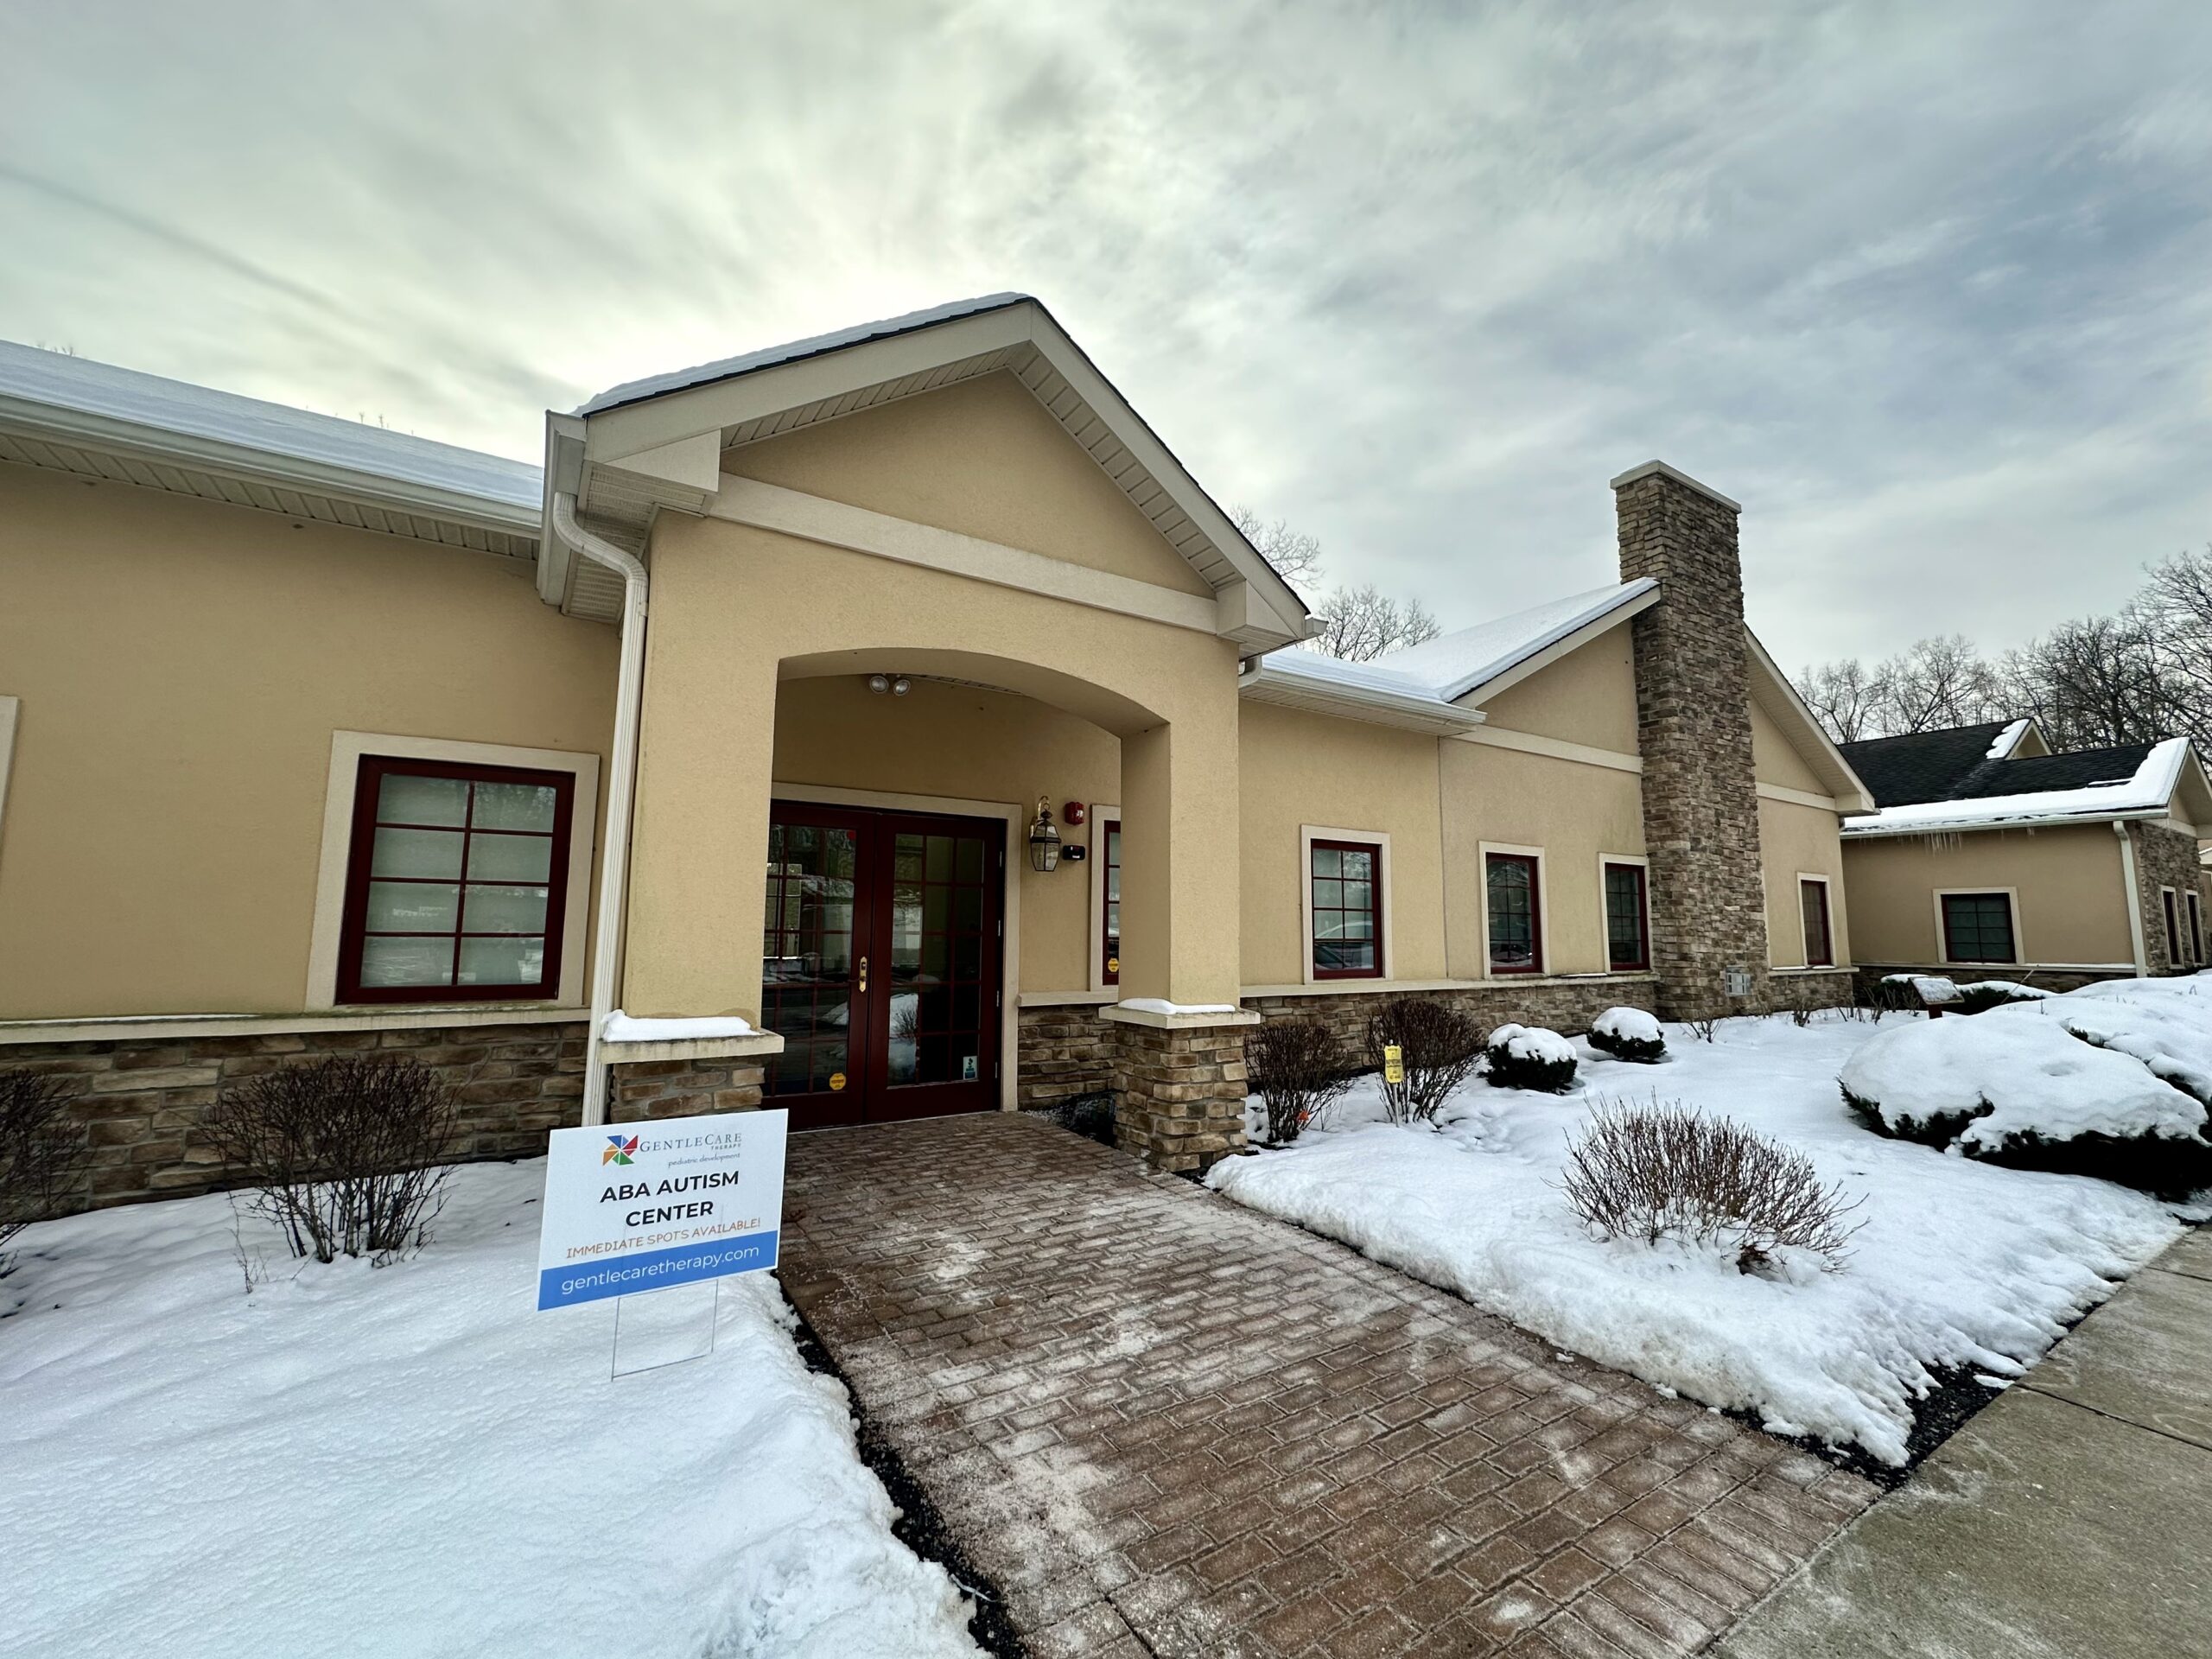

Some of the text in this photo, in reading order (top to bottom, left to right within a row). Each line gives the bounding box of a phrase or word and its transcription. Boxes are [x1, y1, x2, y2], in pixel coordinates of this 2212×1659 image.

[668, 1152, 741, 1168] pediatric development
[600, 1171, 739, 1203] ABA AUTISM
[626, 1201, 714, 1227] CENTER
[566, 1217, 760, 1259] IMMEDIATE SPOTS AVAILABLE!
[562, 1245, 760, 1294] gentlecaretherapy.com
